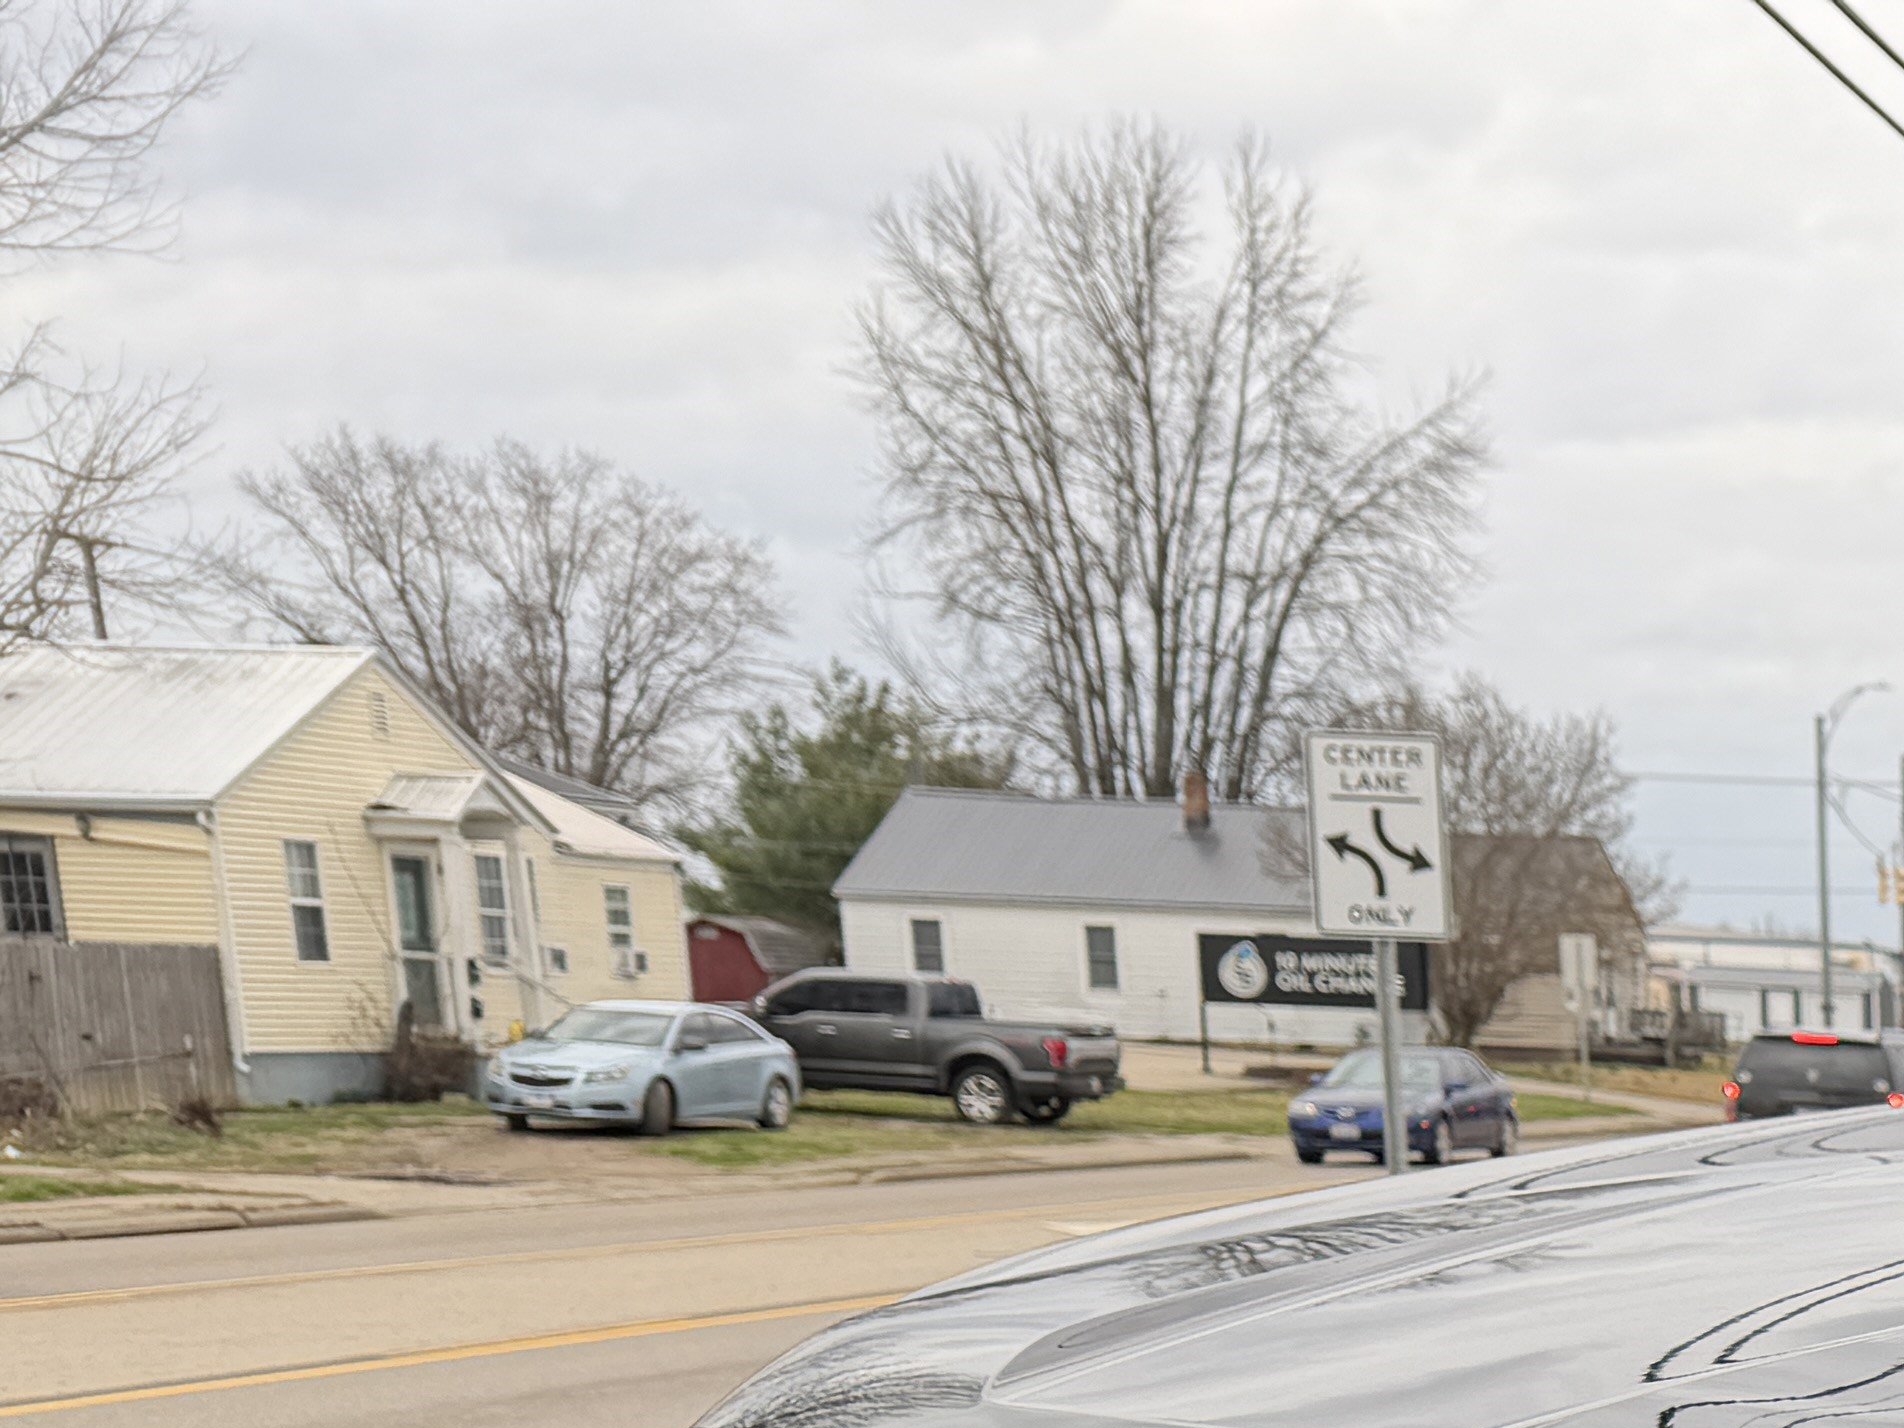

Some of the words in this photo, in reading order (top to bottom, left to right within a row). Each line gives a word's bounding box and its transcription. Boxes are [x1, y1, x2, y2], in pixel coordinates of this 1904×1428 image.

[1322, 743, 1424, 768] CENTER
[1338, 770, 1409, 793] LANE
[1348, 904, 1415, 926] ONLY
[1274, 950, 1299, 971] 10
[1274, 969, 1314, 993] OIL
[1313, 971, 1407, 997] CHANE
